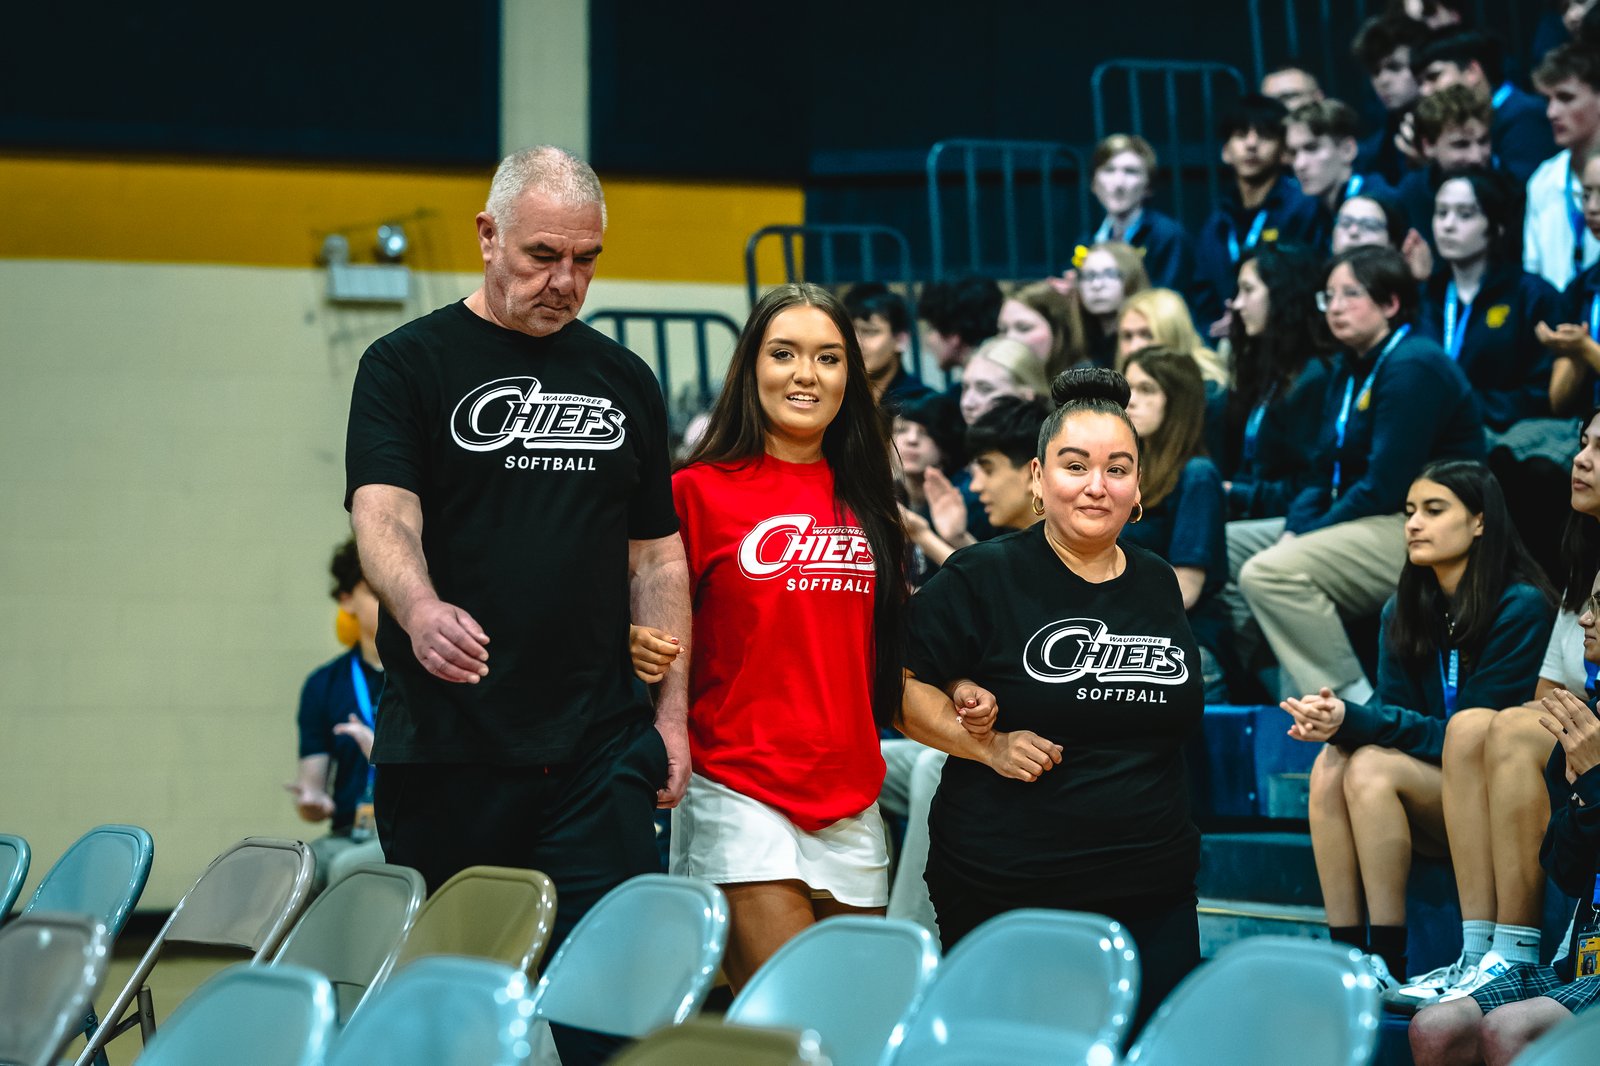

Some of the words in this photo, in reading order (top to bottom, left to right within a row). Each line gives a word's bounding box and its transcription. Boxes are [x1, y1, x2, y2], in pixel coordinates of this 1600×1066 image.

[541, 395, 604, 405] WAUBONSEE
[450, 376, 627, 452] CHIEFS
[504, 455, 597, 471] SOFTBALL
[812, 528, 867, 536] WAUBONSE
[786, 578, 870, 594] SOFTBALL
[1109, 636, 1163, 644] WAUBONSEE
[1023, 617, 1189, 685] CHIEFS
[1076, 687, 1168, 704] SOFTBALL
